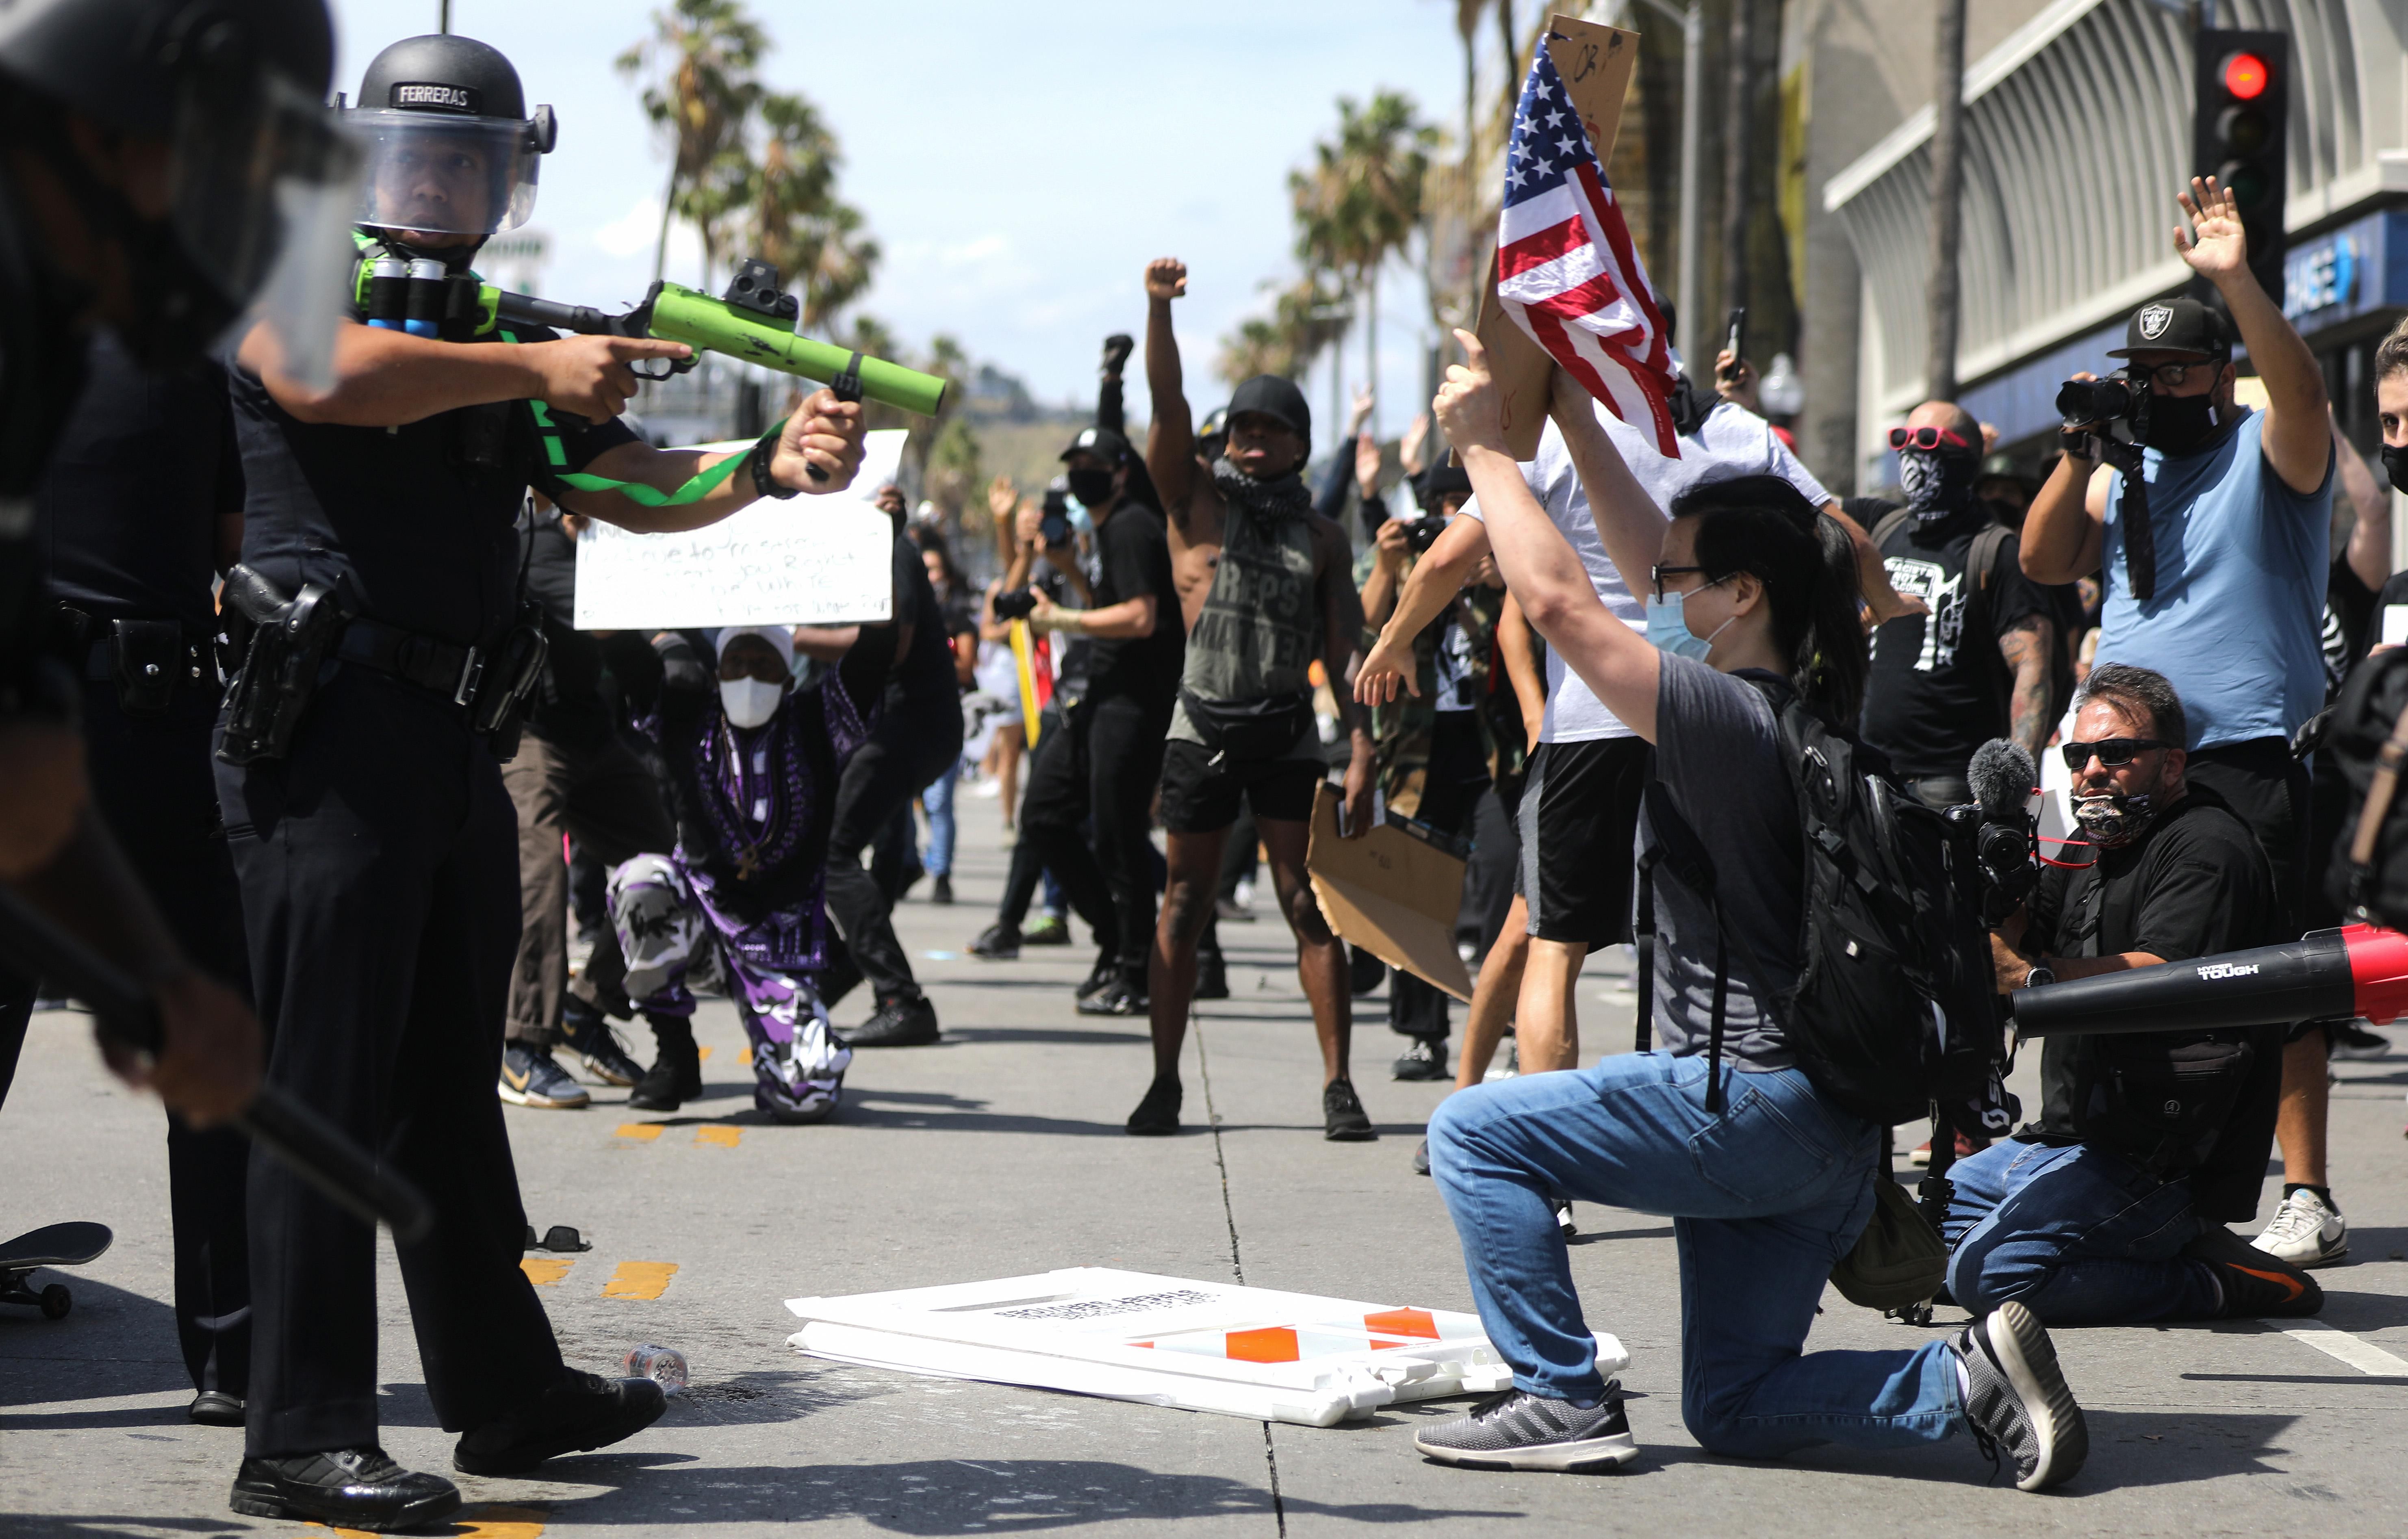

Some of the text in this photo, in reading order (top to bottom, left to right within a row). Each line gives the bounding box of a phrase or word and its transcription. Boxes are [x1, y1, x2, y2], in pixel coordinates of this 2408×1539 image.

[400, 85, 468, 106] FERRERAS
[1891, 571, 1918, 584] NOT
[1216, 560, 1301, 618] REPS
[2197, 963, 2232, 972] HYPER
[2198, 964, 2259, 980] TOUGH
[994, 1290, 1201, 1318] STREET SERVICES
